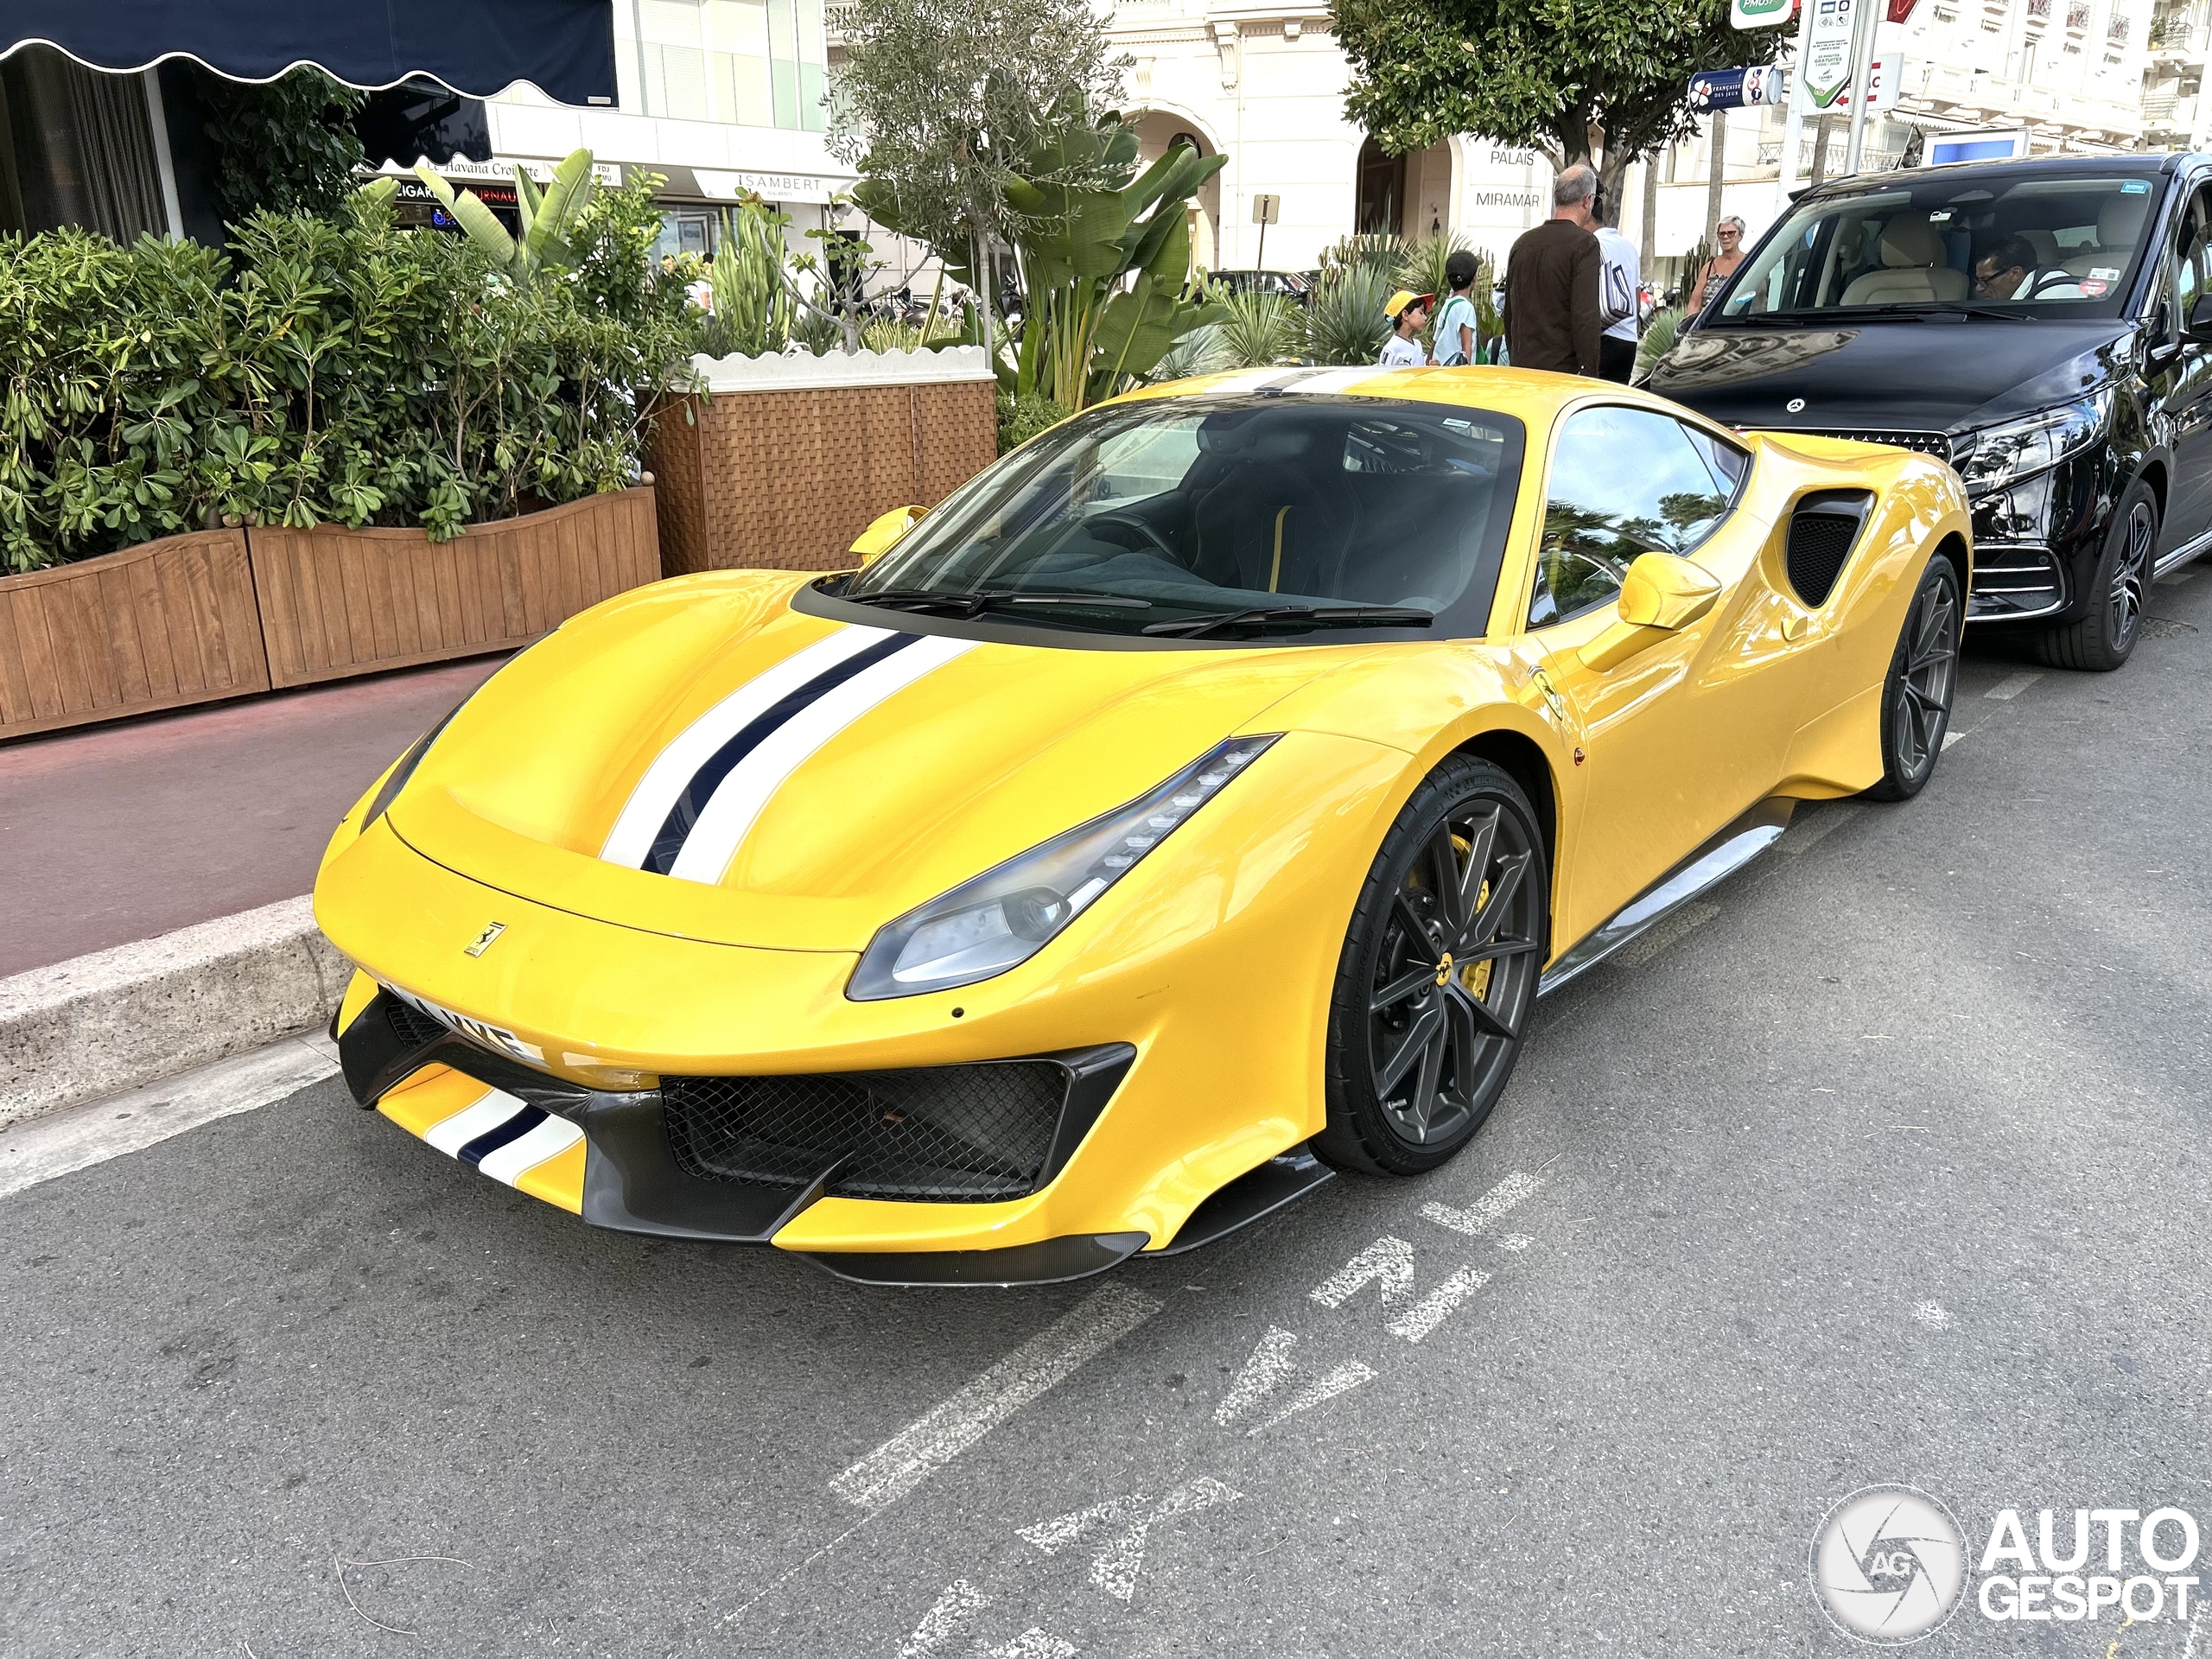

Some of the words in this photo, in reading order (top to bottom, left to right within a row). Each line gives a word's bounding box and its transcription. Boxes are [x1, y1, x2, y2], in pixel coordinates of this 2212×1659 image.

[1491, 150, 1535, 166] PALAIS
[492, 162, 539, 177] Croitte
[738, 175, 821, 191] ISAMBERT
[1476, 192, 1540, 207] MIRAMAR
